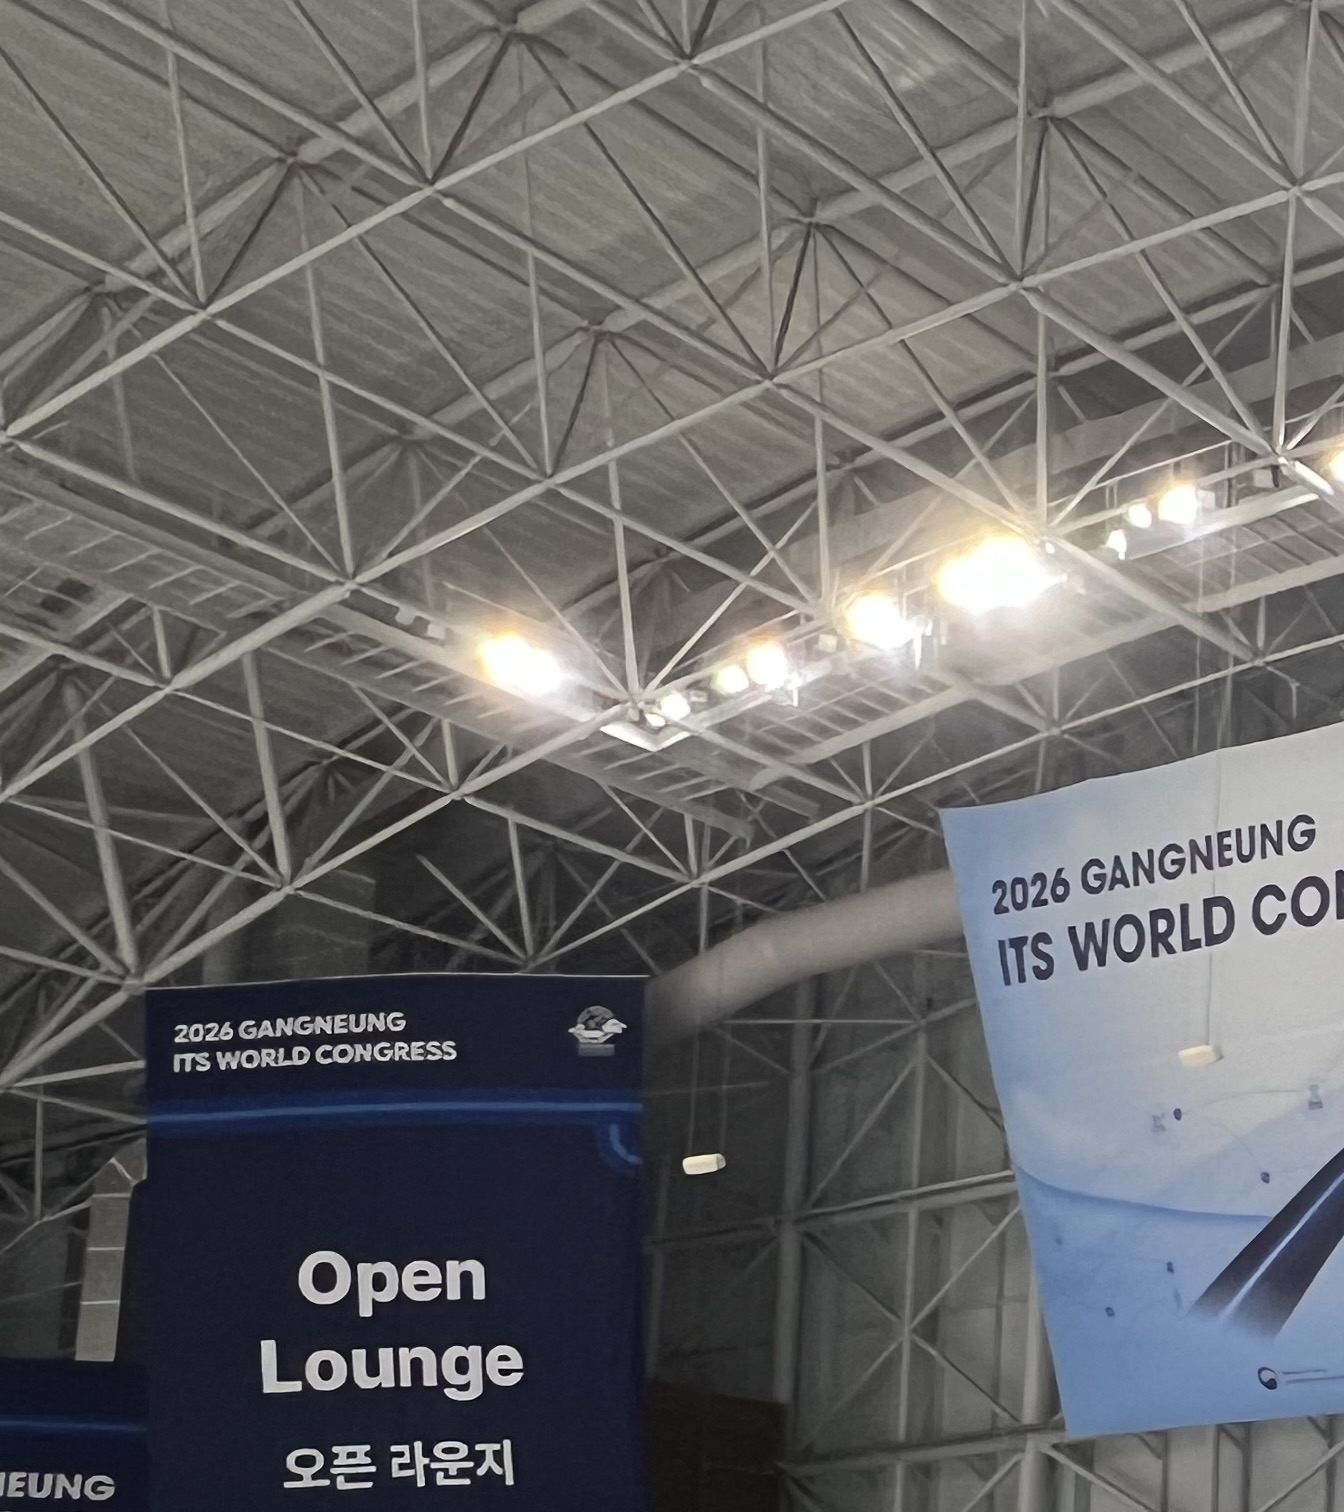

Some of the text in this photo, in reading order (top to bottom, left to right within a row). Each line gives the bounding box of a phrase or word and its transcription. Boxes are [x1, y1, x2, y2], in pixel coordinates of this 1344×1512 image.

[992, 814, 1317, 915] 2026 GANGNEUNG
[997, 931, 1055, 987] ITS
[1066, 895, 1236, 972] WORLD
[173, 1040, 458, 1073] ITS WORLD CONGRESS
[174, 1011, 408, 1043] 2026 GANGNEUNG
[298, 1249, 487, 1318] Open
[260, 1339, 525, 1402] Lounge
[283, 1439, 516, 1490] 오픈 라운지
